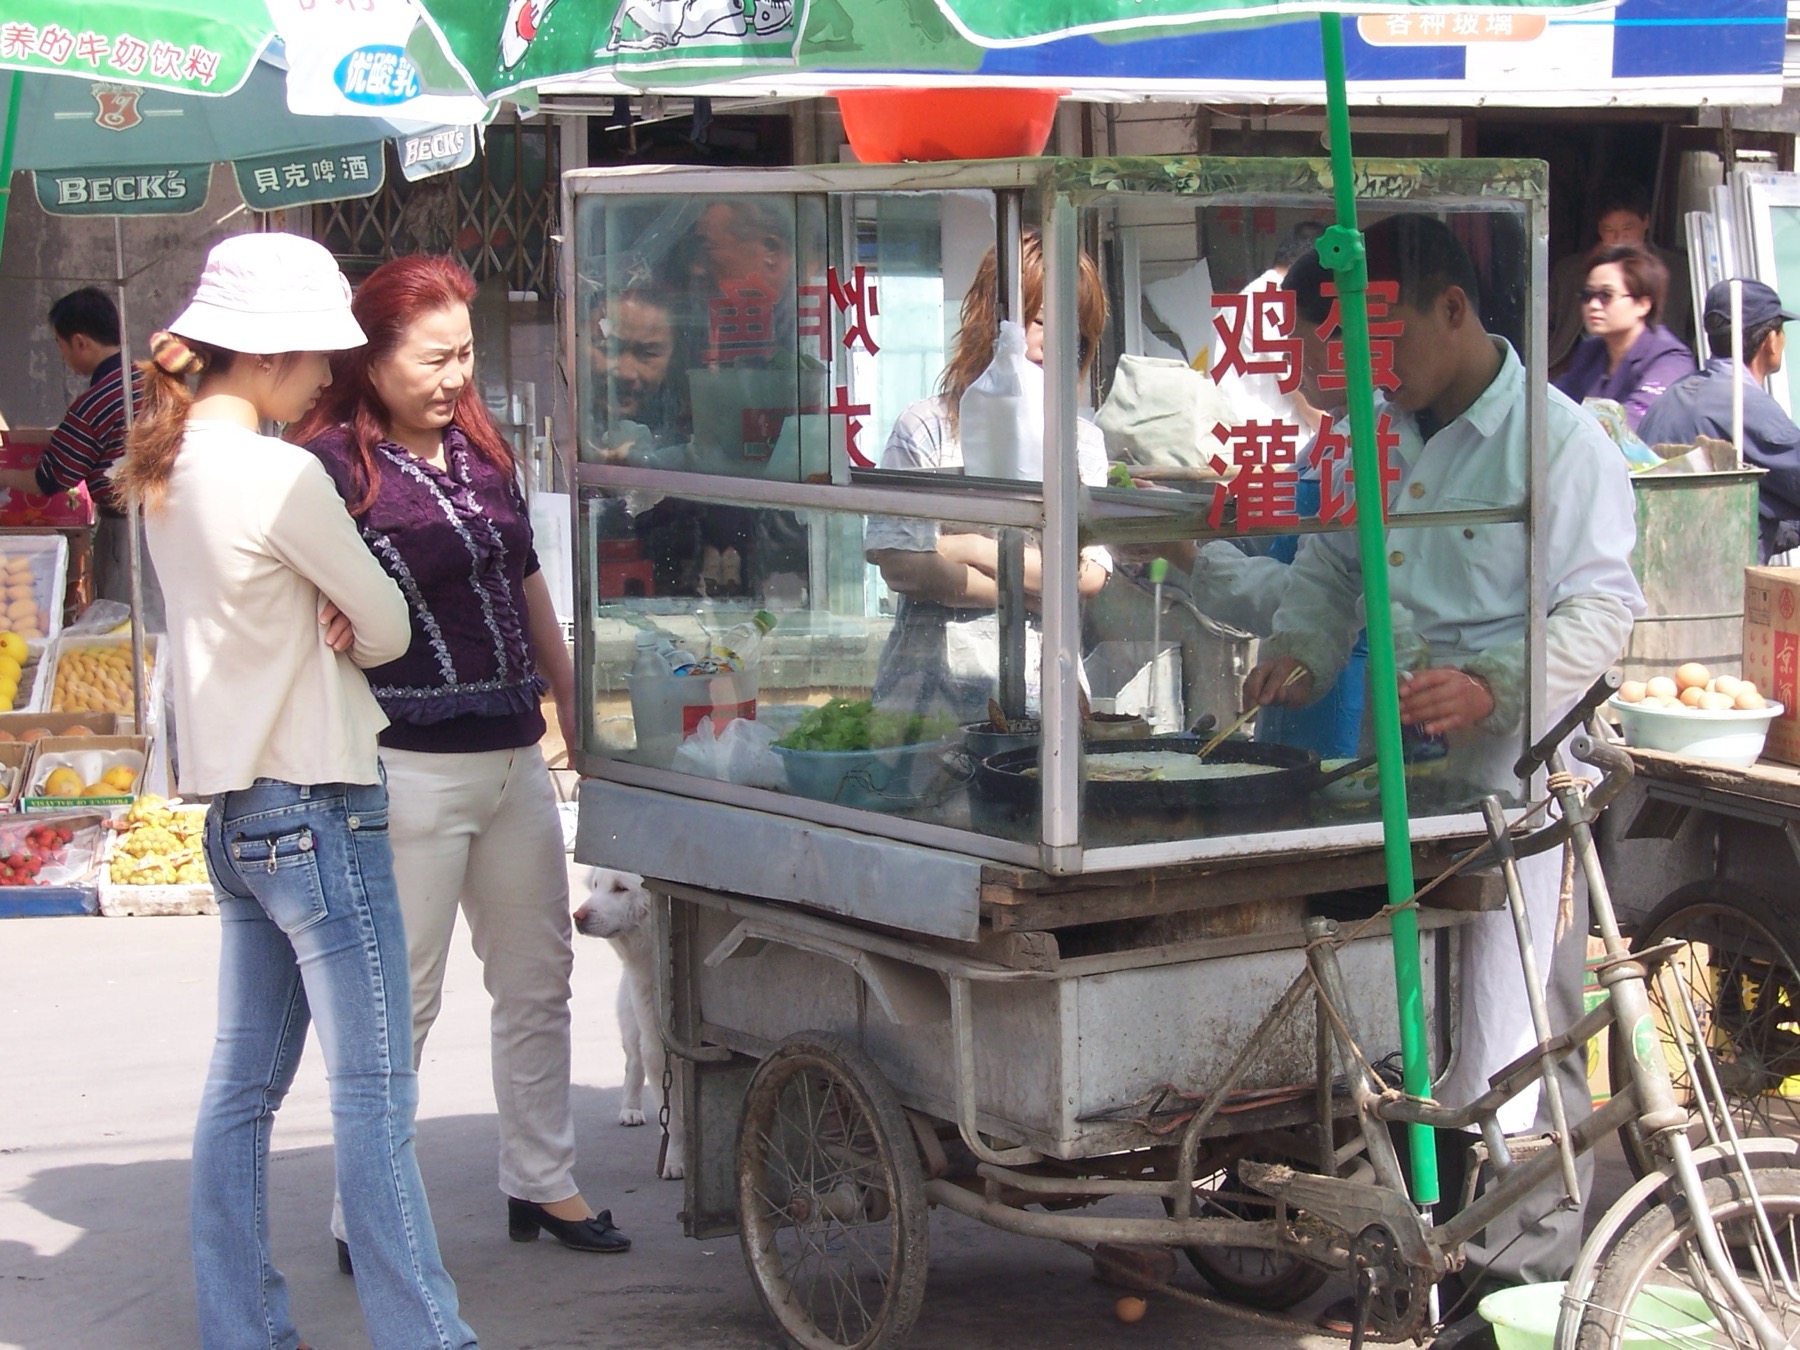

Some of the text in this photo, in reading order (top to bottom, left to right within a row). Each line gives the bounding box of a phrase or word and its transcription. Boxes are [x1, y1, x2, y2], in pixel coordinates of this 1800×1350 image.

[2, 23, 219, 85] 养的牛奶饮料
[345, 51, 418, 98] 优酸乳
[253, 155, 369, 194] 貝克啤酒
[30, 799, 74, 807] MALAYSIA
